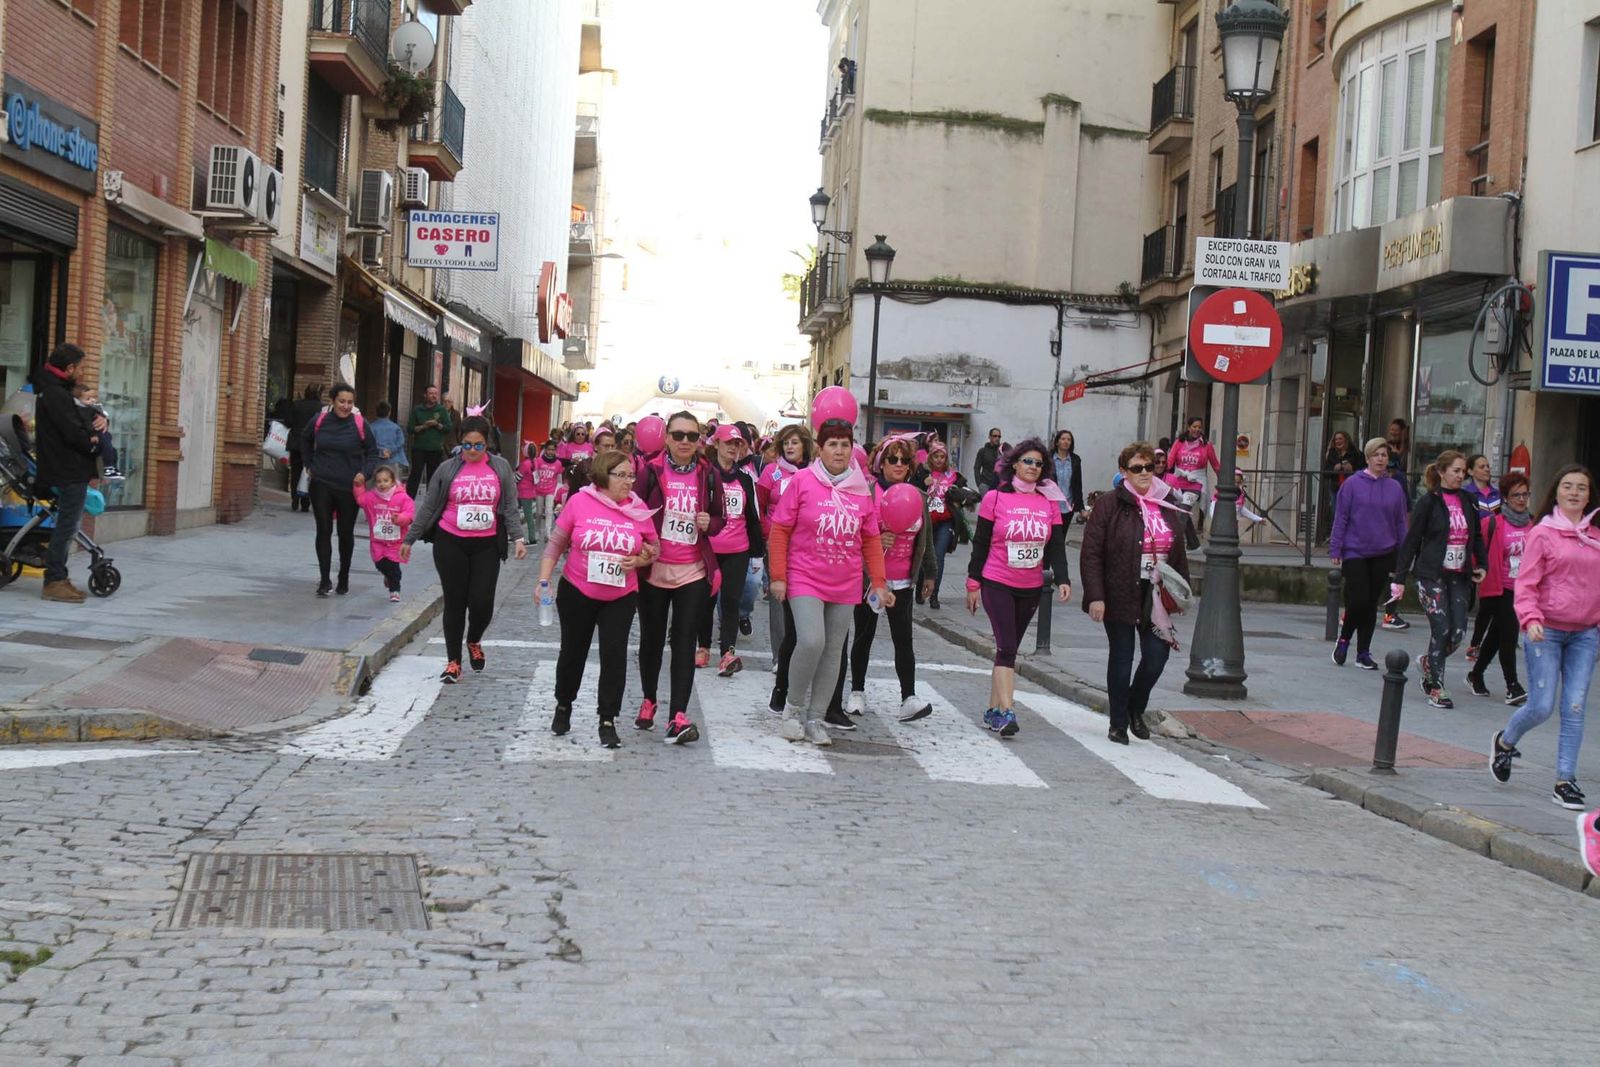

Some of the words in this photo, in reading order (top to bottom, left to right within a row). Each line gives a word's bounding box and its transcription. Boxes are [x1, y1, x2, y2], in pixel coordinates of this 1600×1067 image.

[412, 212, 496, 225] ALMACENES
[417, 227, 490, 243] CASERO
[1208, 240, 1242, 253] EXCEPTO
[1243, 243, 1278, 255] GARAJES
[409, 257, 442, 266] OFERTAS
[445, 259, 467, 267] TODO
[479, 259, 496, 268] AÑO
[1205, 253, 1225, 265] SOLO
[1227, 255, 1242, 266] CON
[1244, 257, 1265, 268] GRAN
[1268, 259, 1281, 269] VIA
[1202, 267, 1237, 280] CORTADA
[1239, 270, 1249, 281] AL
[1250, 271, 1281, 283] TRAFICO
[1550, 347, 1575, 359] PLAZA
[1577, 349, 1588, 359] DE
[465, 512, 489, 523] 240
[669, 520, 694, 534] 156
[1017, 548, 1039, 560] 528
[598, 562, 622, 577] 150
